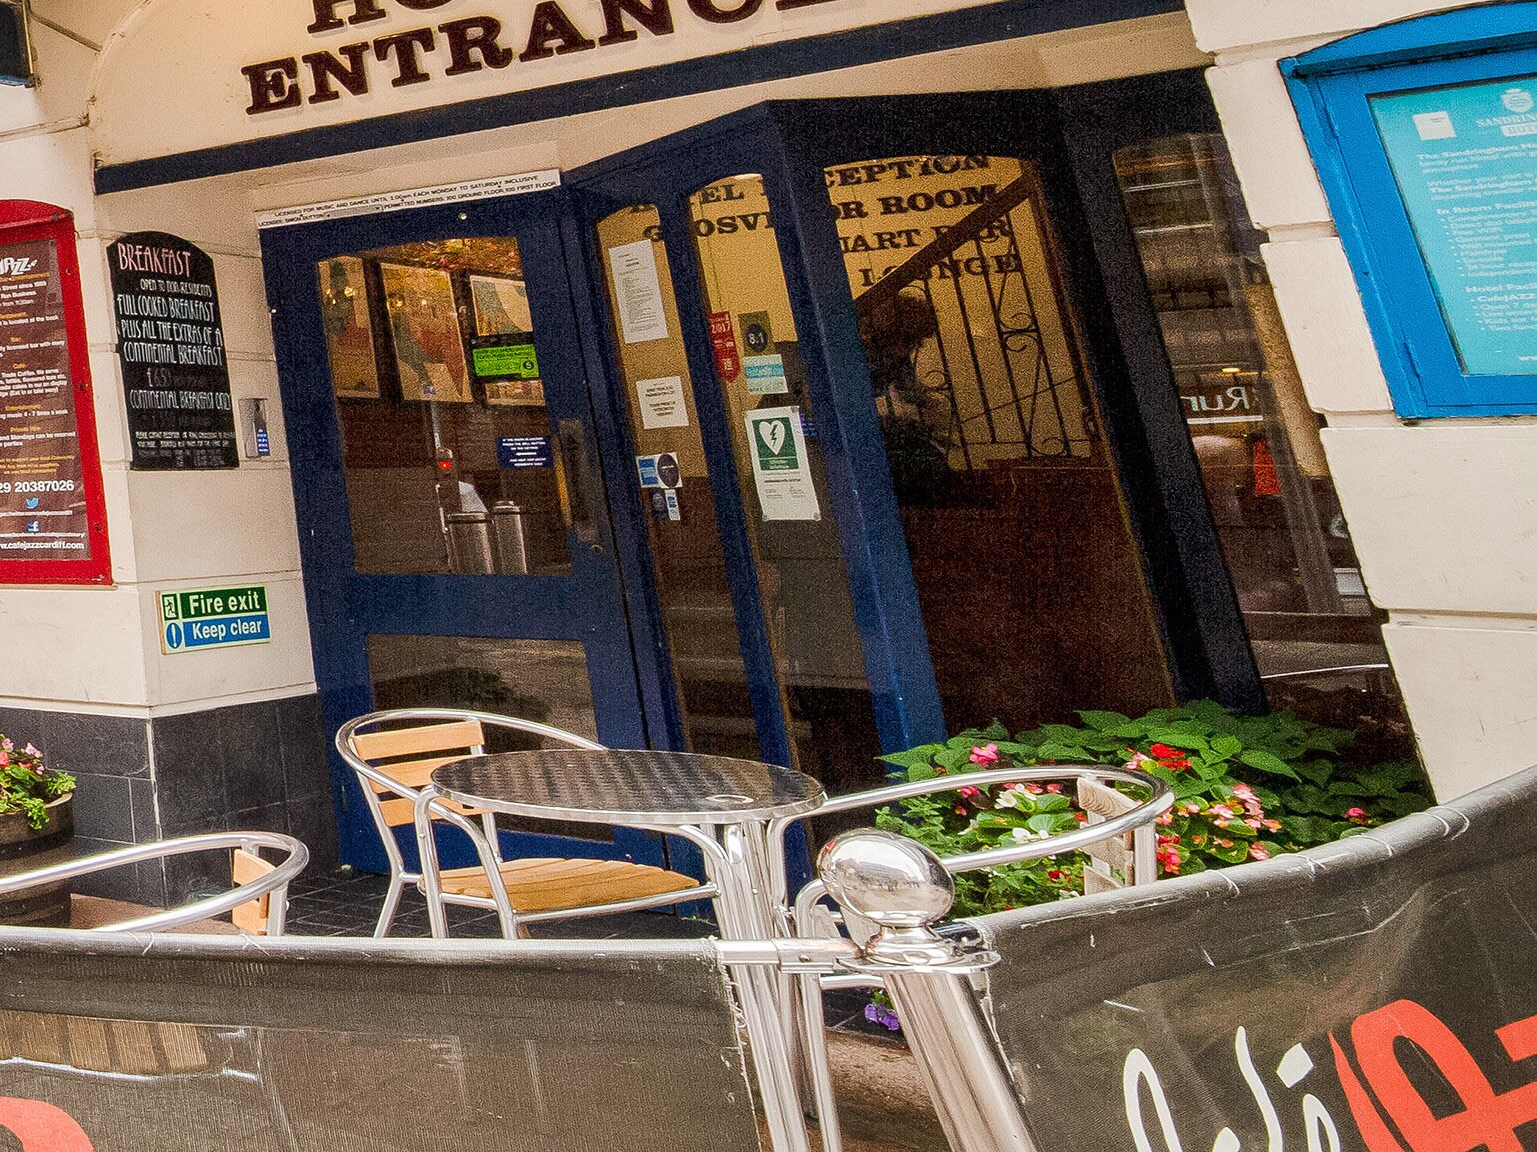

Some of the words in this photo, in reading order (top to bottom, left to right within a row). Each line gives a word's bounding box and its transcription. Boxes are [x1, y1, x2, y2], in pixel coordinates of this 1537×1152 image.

[316, 204, 334, 212] MUSIC
[350, 199, 369, 208] DANCE
[371, 197, 388, 205] UNTIL
[431, 186, 457, 195] MONDAY
[470, 180, 502, 190] SATURDAY
[505, 175, 538, 185] INCLUSIVE
[536, 181, 556, 189] FLOOR
[877, 184, 997, 215] ROOM
[118, 243, 191, 277] BREAKFAST
[140, 278, 157, 291] OPEN
[117, 294, 138, 315] FULL
[138, 296, 168, 317] COOKED
[169, 297, 214, 322] BREAKFAST
[121, 320, 141, 338] PLUS
[142, 320, 157, 339] ALL
[157, 321, 172, 341] THE
[172, 322, 203, 345] EXTRAS
[203, 327, 212, 345] OF
[215, 328, 223, 346] A
[123, 342, 177, 364] CONTINENTAL
[177, 345, 223, 366] BREAKFAST
[130, 389, 179, 409] CONTINENTAL
[15, 480, 75, 493] 20387026
[189, 594, 223, 615] Fire
[228, 590, 260, 611] exit
[192, 622, 226, 640] Keep
[230, 619, 262, 635] clear
